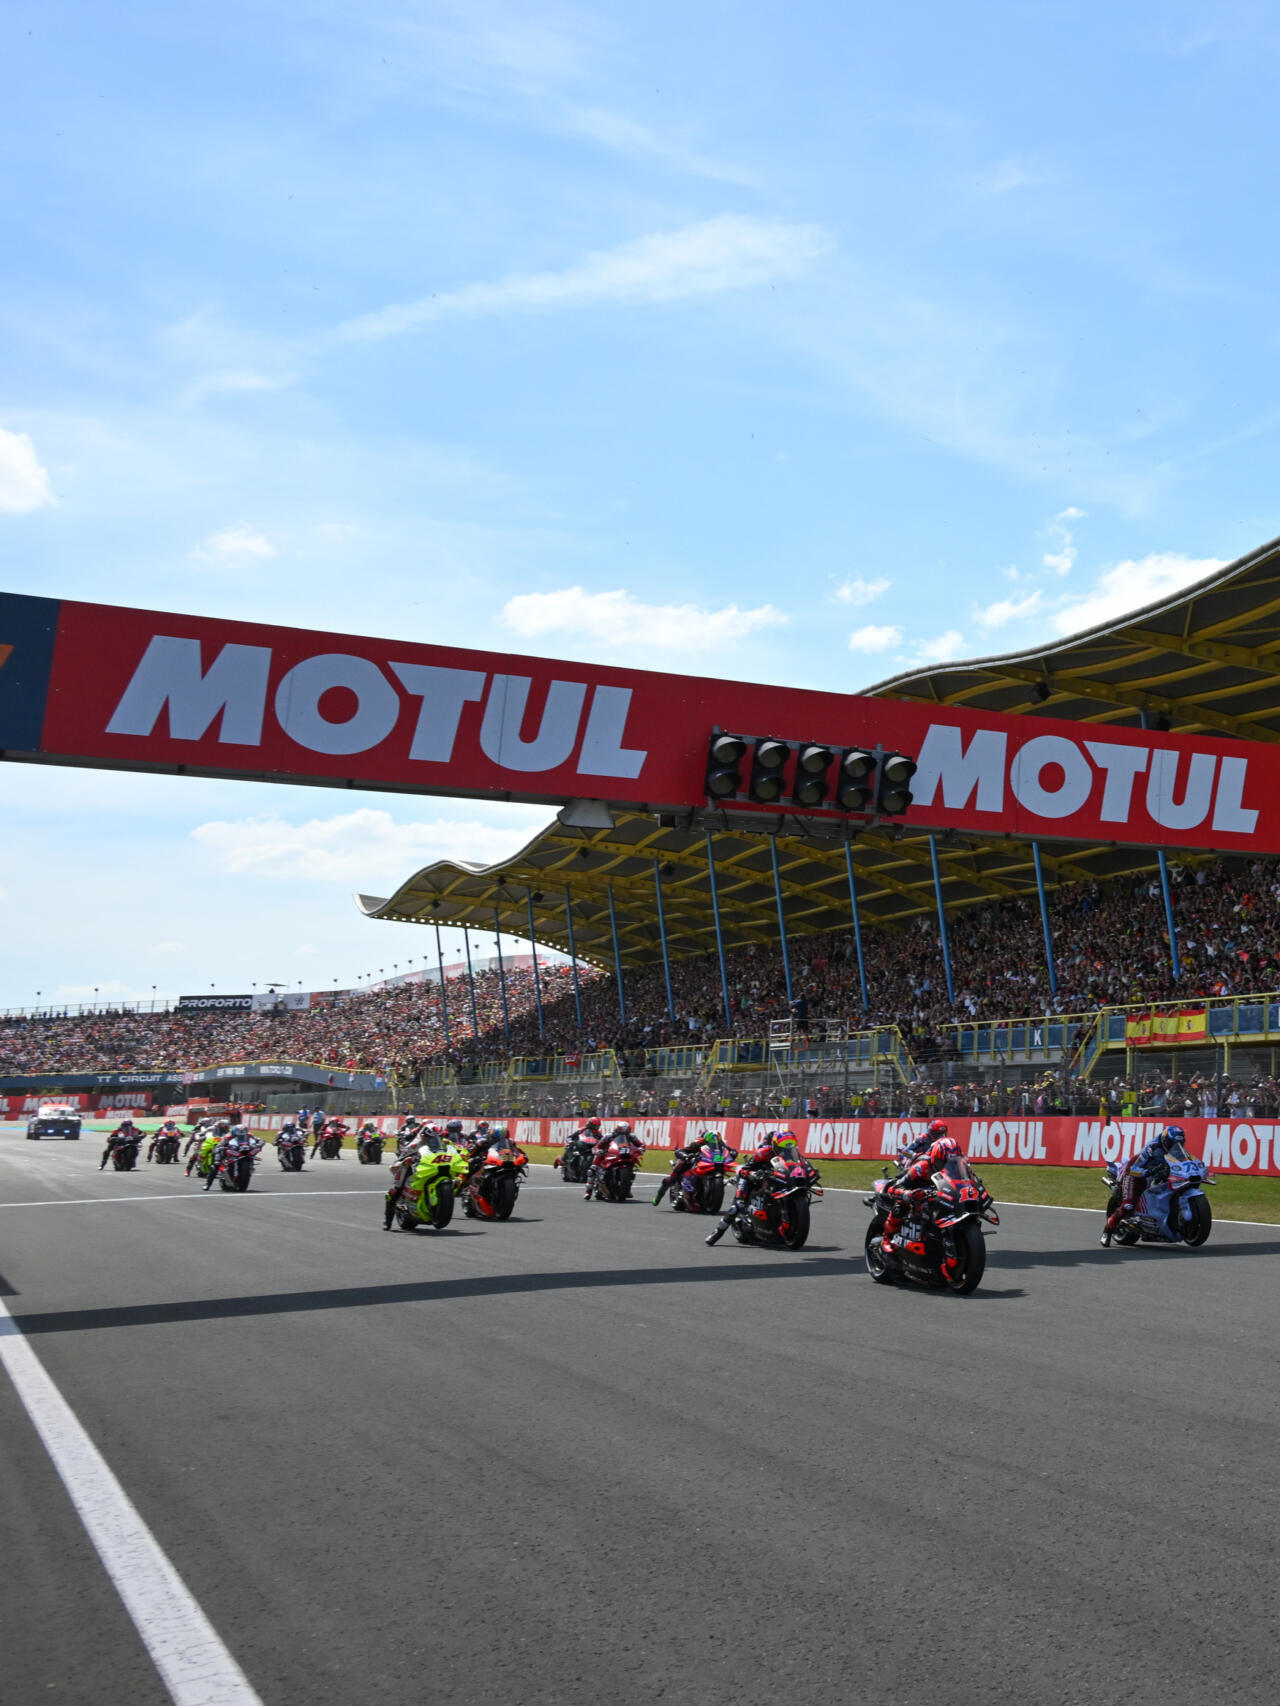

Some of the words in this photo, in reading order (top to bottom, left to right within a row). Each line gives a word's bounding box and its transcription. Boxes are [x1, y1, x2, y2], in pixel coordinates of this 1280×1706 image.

[105, 635, 648, 779] MOTUL
[913, 724, 1260, 834] MOTUL
[179, 998, 252, 1008] PROFORTO
[1034, 1029, 1042, 1046] K
[97, 1075, 113, 1083] TT
[119, 1075, 163, 1083] CIRCUIT
[99, 1094, 147, 1109] MOTUL
[805, 1122, 862, 1155] MOTUL
[968, 1121, 1047, 1160] MOTUL
